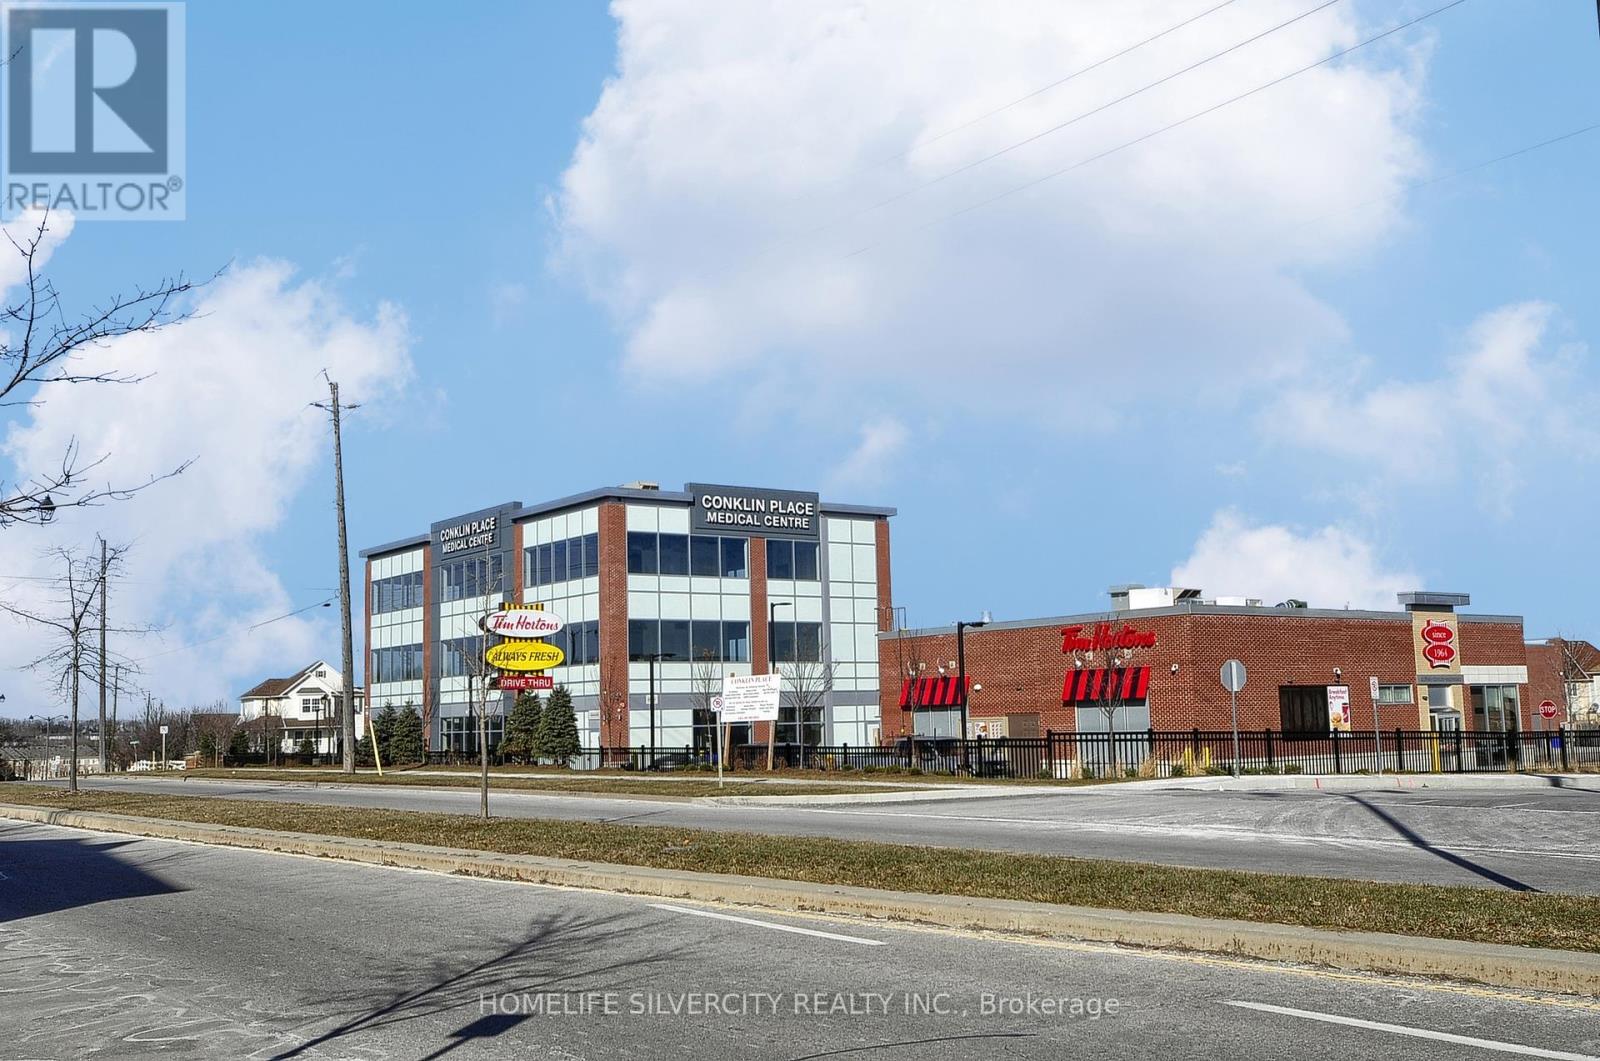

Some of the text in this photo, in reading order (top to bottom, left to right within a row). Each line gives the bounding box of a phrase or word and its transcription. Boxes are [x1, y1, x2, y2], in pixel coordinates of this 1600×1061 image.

[702, 495, 814, 515] CONKLIN PLACE
[707, 511, 809, 529] MEDICAL CENTRE
[440, 517, 496, 542] CONKLIN PLACE
[442, 539, 468, 554] MEDICAL
[493, 615, 558, 631] Tim Hortons
[1061, 625, 1092, 654] Tim
[1432, 630, 1446, 638] since
[493, 651, 559, 662] ALWAYS FRESH
[500, 679, 550, 687] DRIVE THRU
